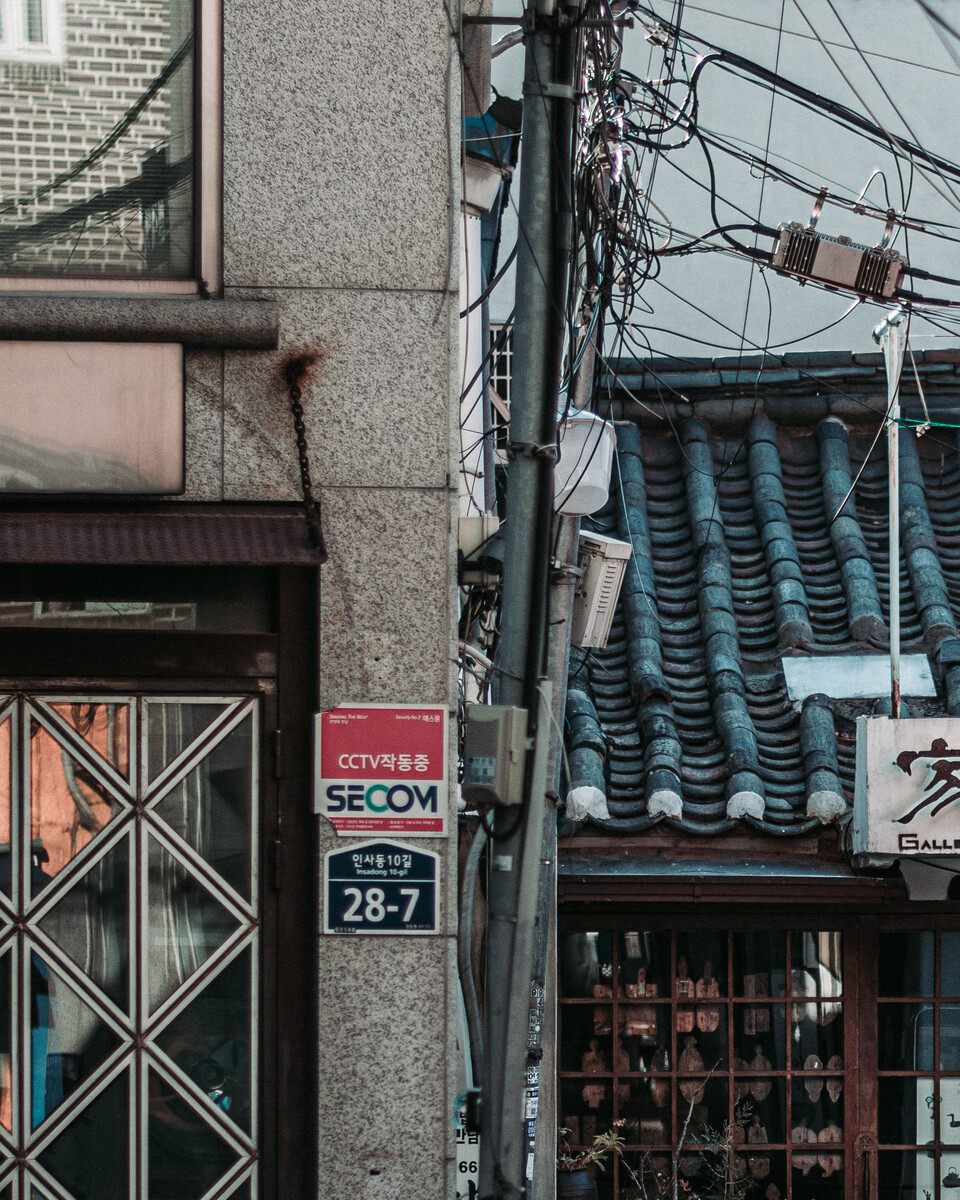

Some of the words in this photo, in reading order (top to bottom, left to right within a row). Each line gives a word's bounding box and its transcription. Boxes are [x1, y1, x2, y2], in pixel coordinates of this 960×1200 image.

[338, 753, 430, 772] CCTV작동중
[326, 784, 438, 813] SECOM
[352, 854, 412, 869] 인사동10길
[343, 887, 420, 923] 28-7
